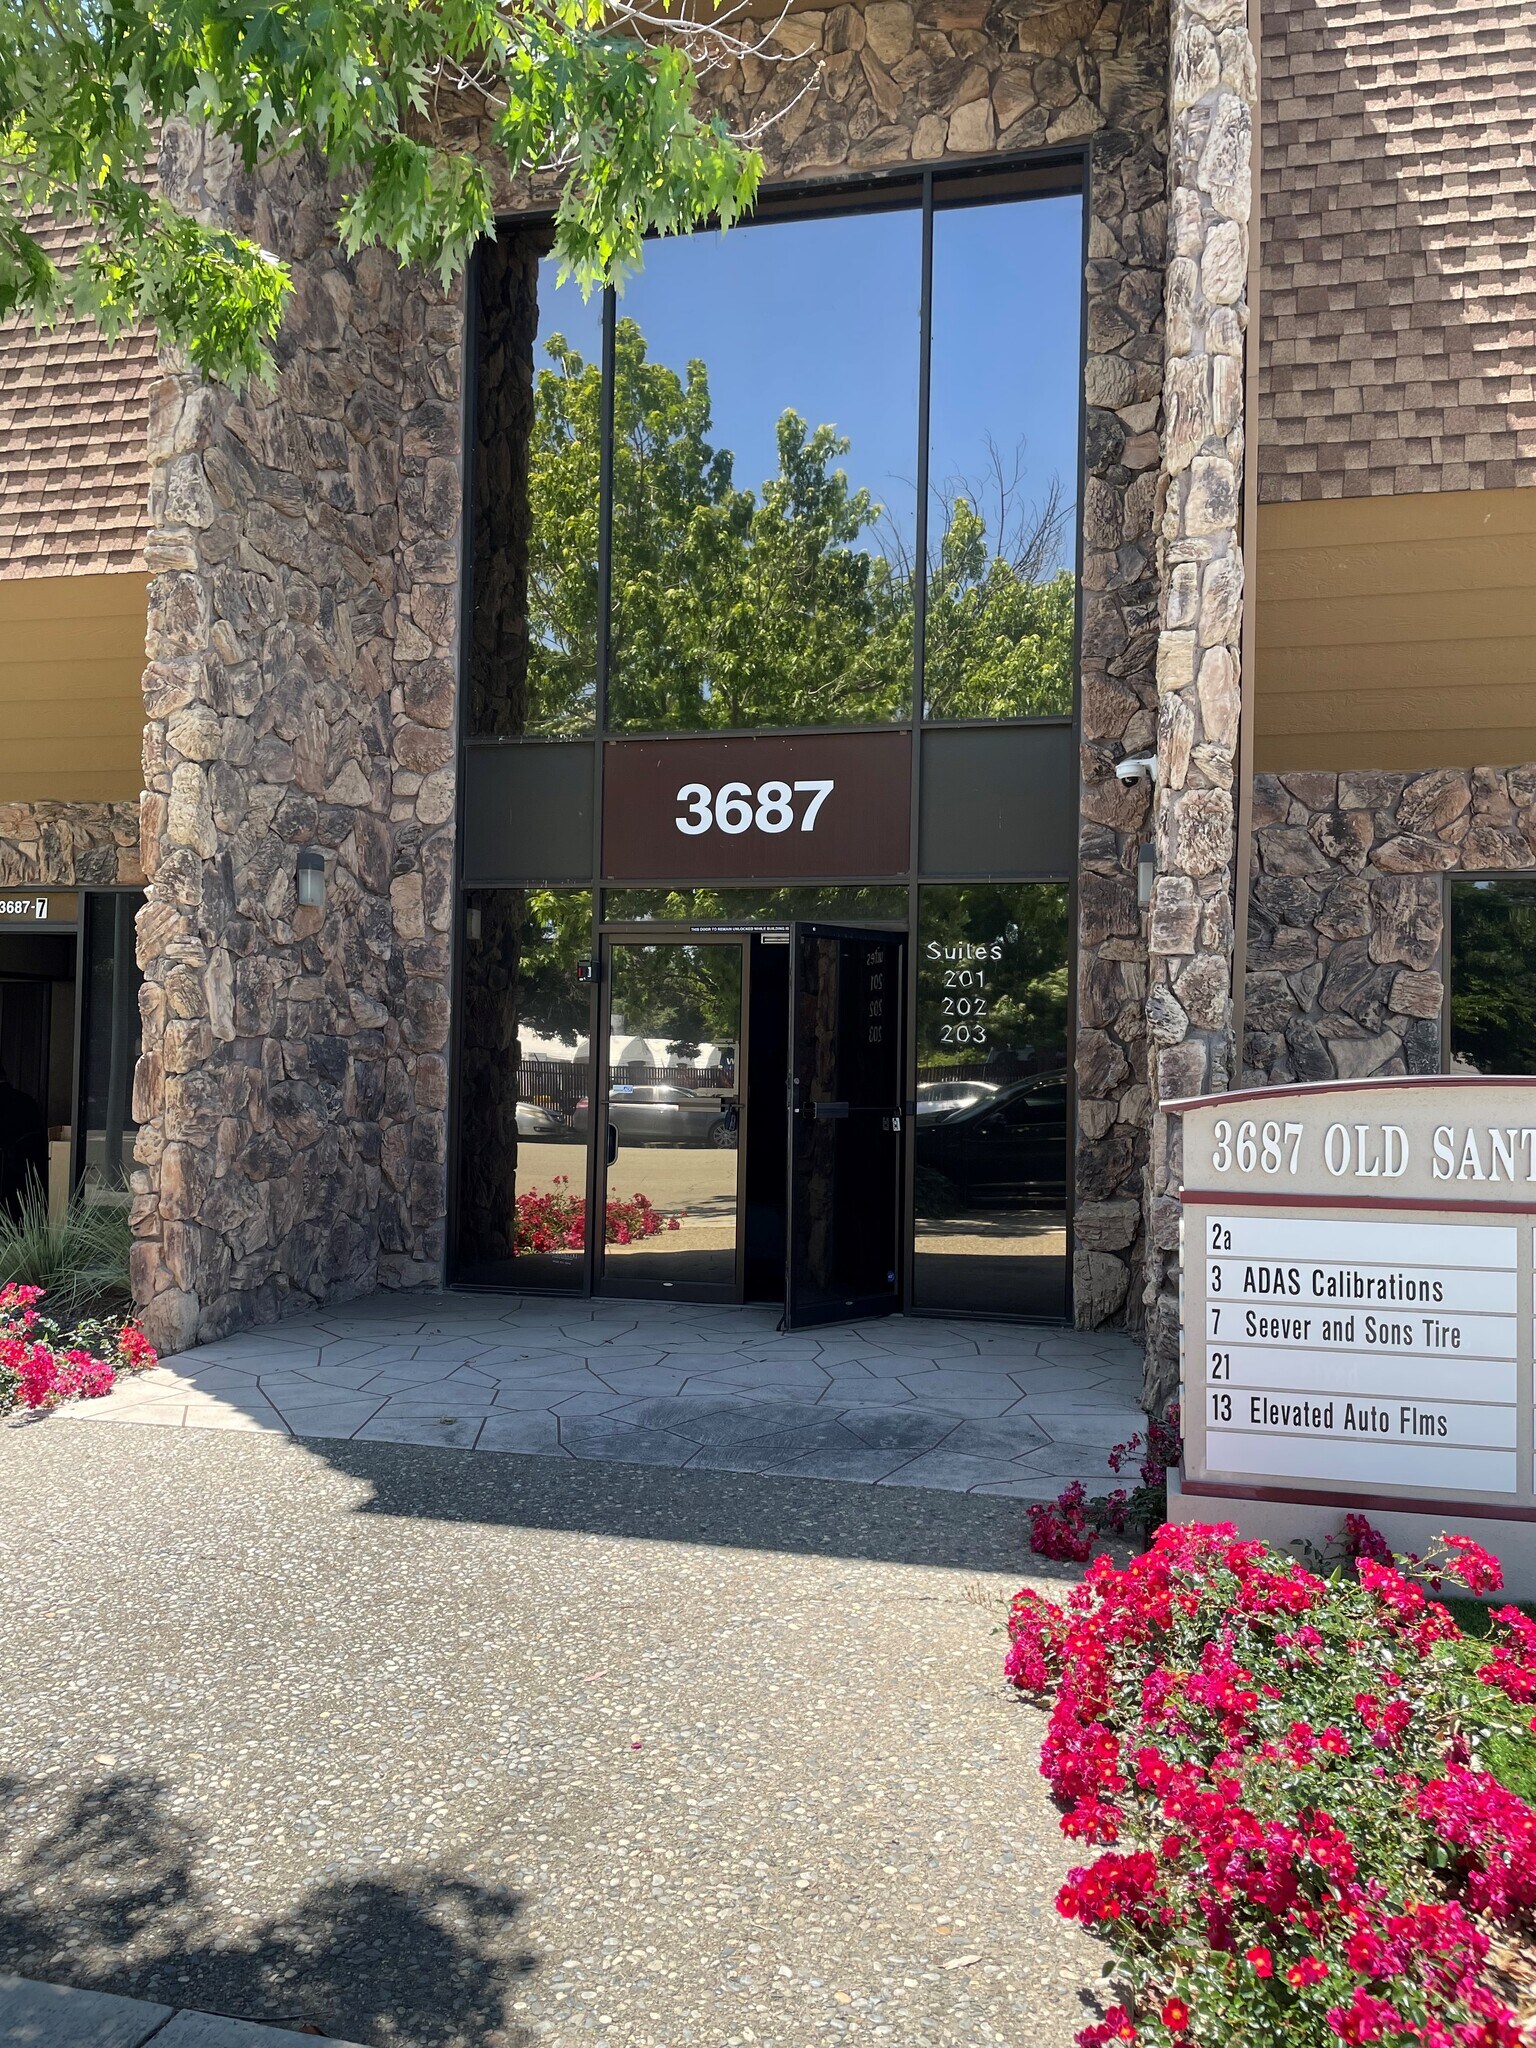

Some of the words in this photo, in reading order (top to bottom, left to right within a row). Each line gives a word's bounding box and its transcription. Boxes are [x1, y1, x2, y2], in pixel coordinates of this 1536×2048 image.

[675, 779, 834, 835] 3687
[926, 941, 1002, 960] Suites
[944, 969, 984, 988] 201
[942, 996, 987, 1016] 202
[940, 1024, 986, 1043] 203
[1212, 1120, 1304, 1175] 3687
[1324, 1123, 1410, 1177] OLD
[1212, 1222, 1232, 1251] 2a
[1211, 1265, 1222, 1293] 3
[1243, 1266, 1301, 1296] ADAS
[1312, 1269, 1444, 1303] Calibrations
[1211, 1308, 1221, 1335] 7
[1245, 1309, 1312, 1341] Seever
[1322, 1315, 1355, 1343] and
[1365, 1315, 1413, 1346] Sons
[1422, 1319, 1461, 1349] Tire
[1211, 1352, 1231, 1380] 21
[1212, 1393, 1232, 1422] 13
[1250, 1396, 1334, 1429] Elevated
[1343, 1402, 1390, 1433] Auto
[1400, 1406, 1448, 1437] Flms
